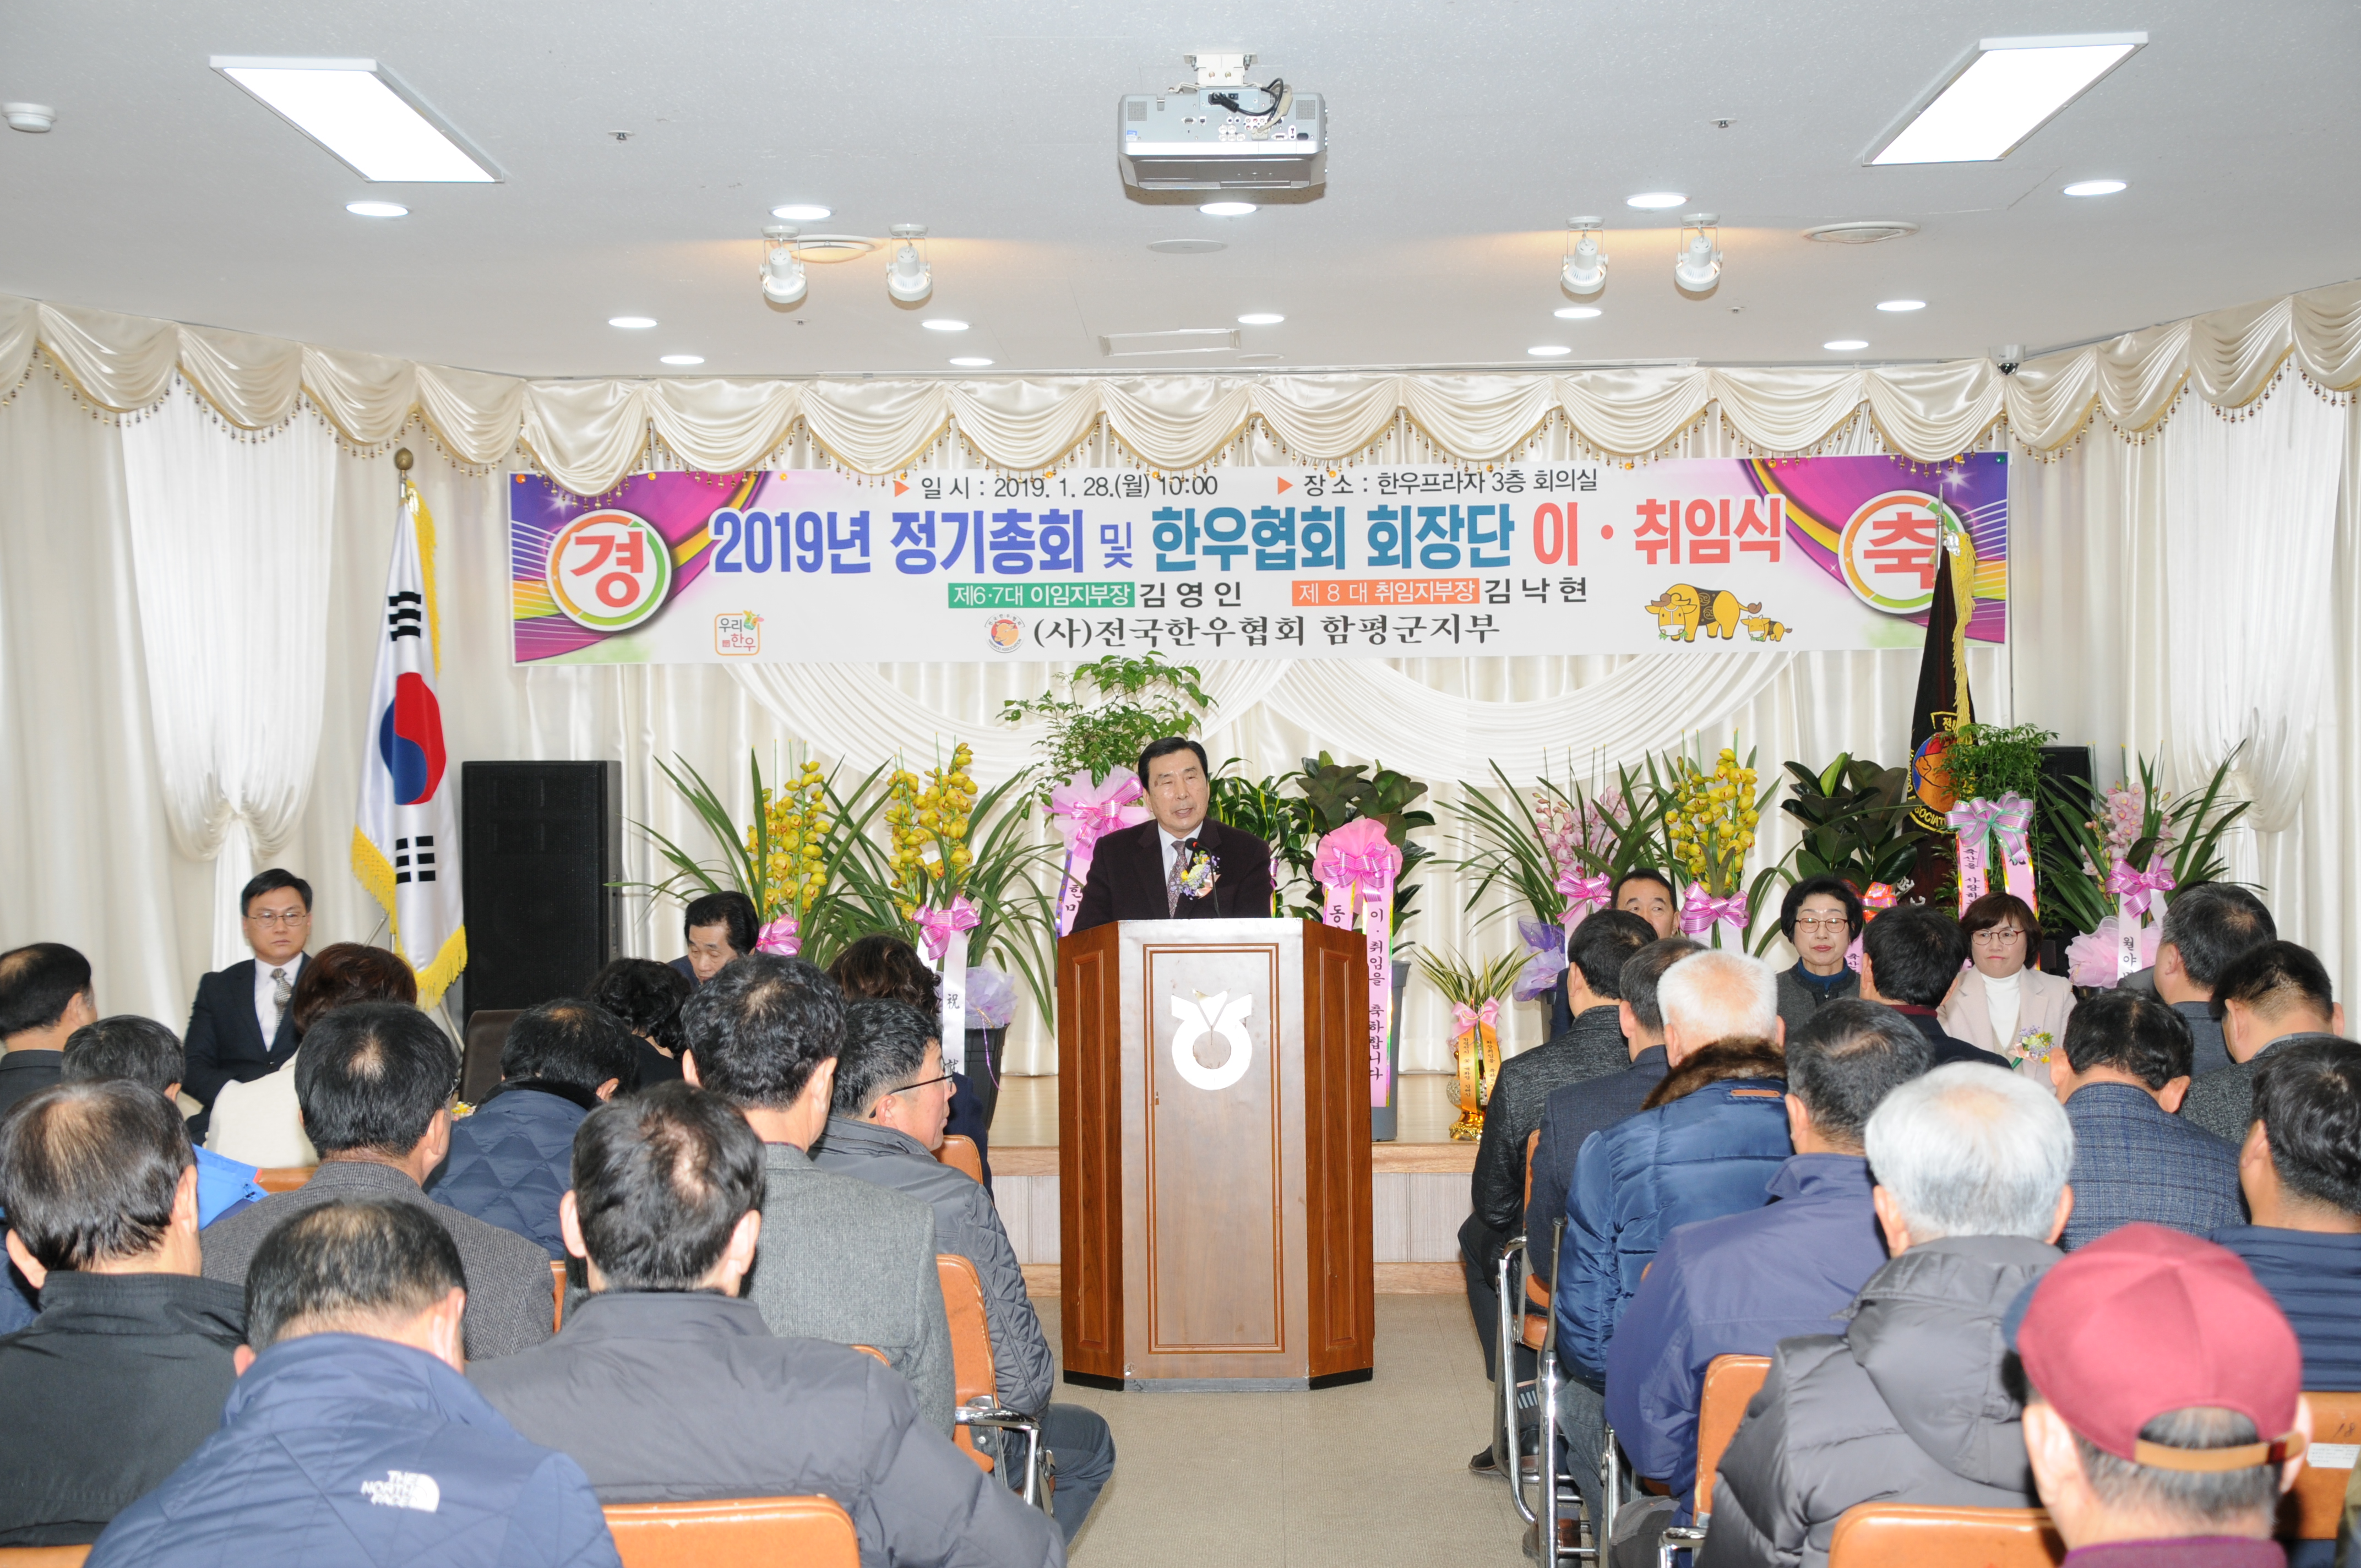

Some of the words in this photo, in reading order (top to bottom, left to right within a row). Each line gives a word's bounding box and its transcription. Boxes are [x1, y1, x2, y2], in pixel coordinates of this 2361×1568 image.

[994, 477, 1049, 498] 2019.
[1160, 476, 1218, 496] 10:00
[1378, 471, 1486, 495] 한우프라자
[1492, 470, 1526, 494] 3층
[1533, 468, 1597, 492] 회의실
[714, 510, 871, 574] 2019년
[890, 508, 1084, 574] 정기총회
[1100, 522, 1133, 569] 및
[1151, 505, 1345, 572] 한우협회
[1367, 503, 1515, 569] 회장단
[1533, 502, 1578, 566] 이
[1634, 498, 1781, 565] 취임식
[1863, 511, 1936, 590] 축
[570, 530, 644, 608] 경
[954, 585, 1023, 606] 제6·7대
[1030, 584, 1131, 606] 이임지부장
[1374, 580, 1475, 603] 취임지부장
[719, 618, 742, 633] 우리
[1034, 616, 1304, 649] (사)전국한우협회
[1320, 612, 1500, 646] 함평군지부
[730, 633, 756, 652] 한우
[946, 993, 960, 1010] 祝
[361, 1480, 414, 1496] NORTH
[387, 1471, 417, 1484] THE
[371, 1493, 410, 1508] FACE
